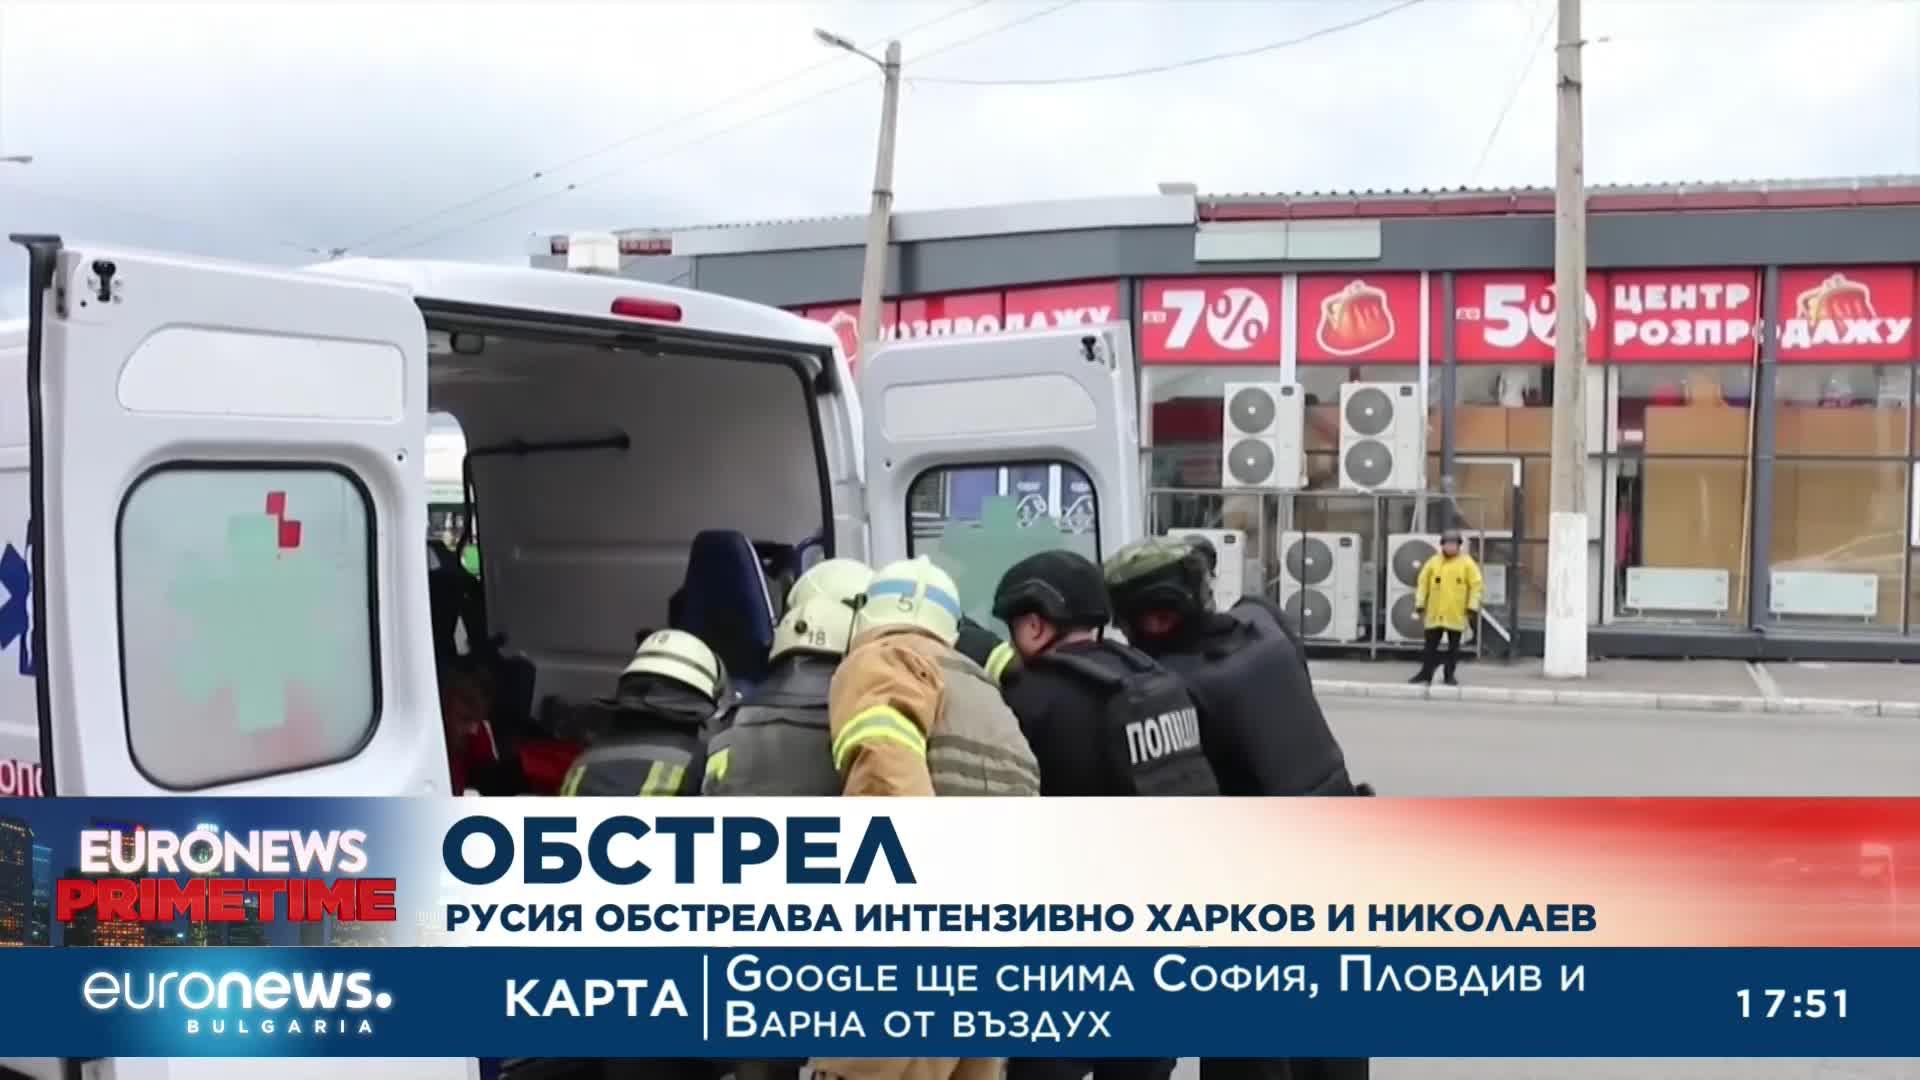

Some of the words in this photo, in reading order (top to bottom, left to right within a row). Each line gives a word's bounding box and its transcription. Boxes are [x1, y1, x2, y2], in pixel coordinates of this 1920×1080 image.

[1615, 284, 1750, 314] ЦЕНТР
[897, 594, 913, 612] 5
[807, 630, 826, 646] 18
